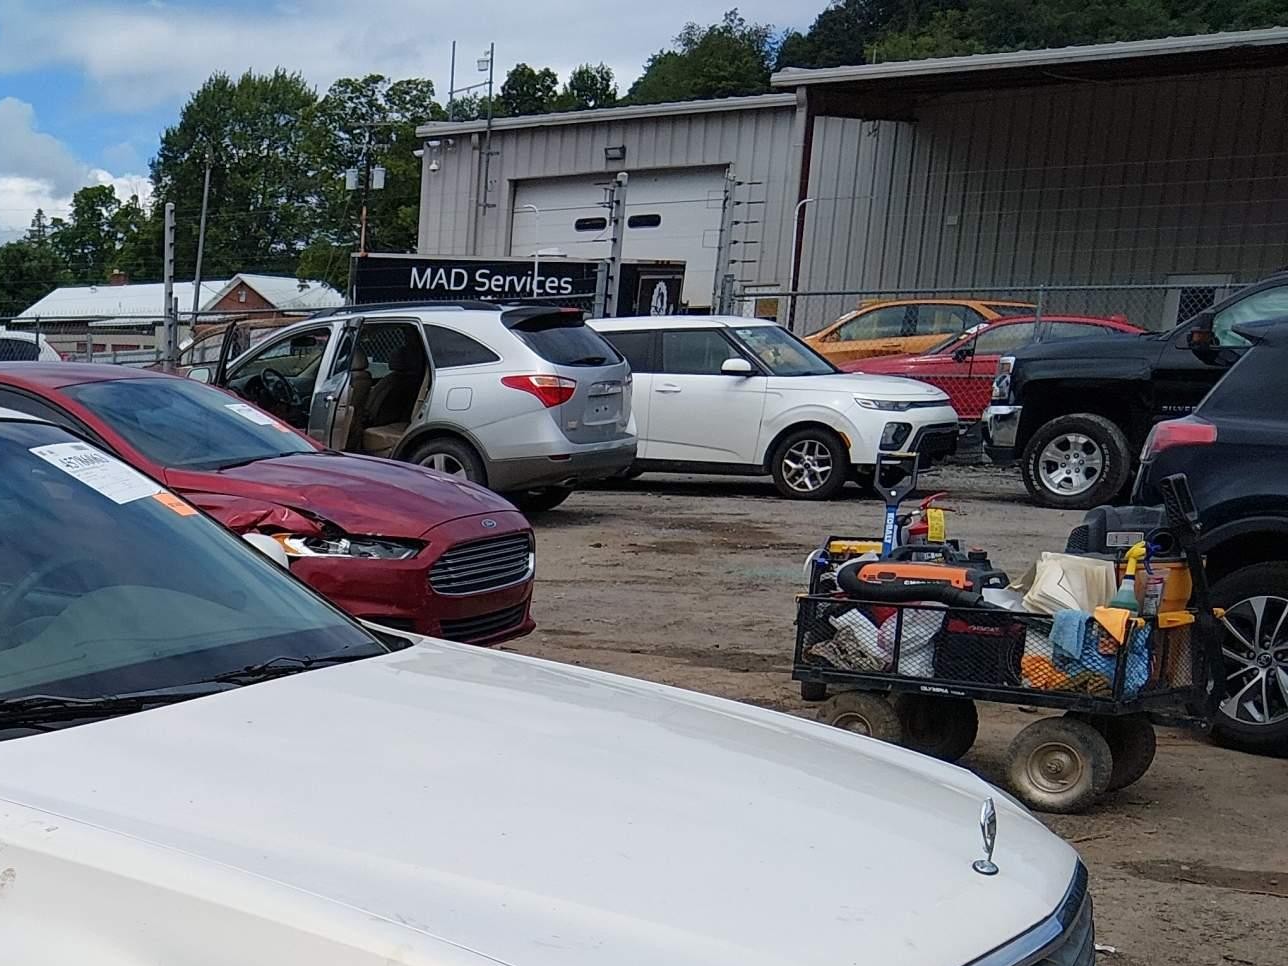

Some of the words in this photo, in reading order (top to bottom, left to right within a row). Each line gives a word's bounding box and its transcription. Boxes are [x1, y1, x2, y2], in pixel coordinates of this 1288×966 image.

[409, 266, 469, 292] MAD
[474, 268, 574, 295] Services
[884, 512, 895, 544] KOBALT
